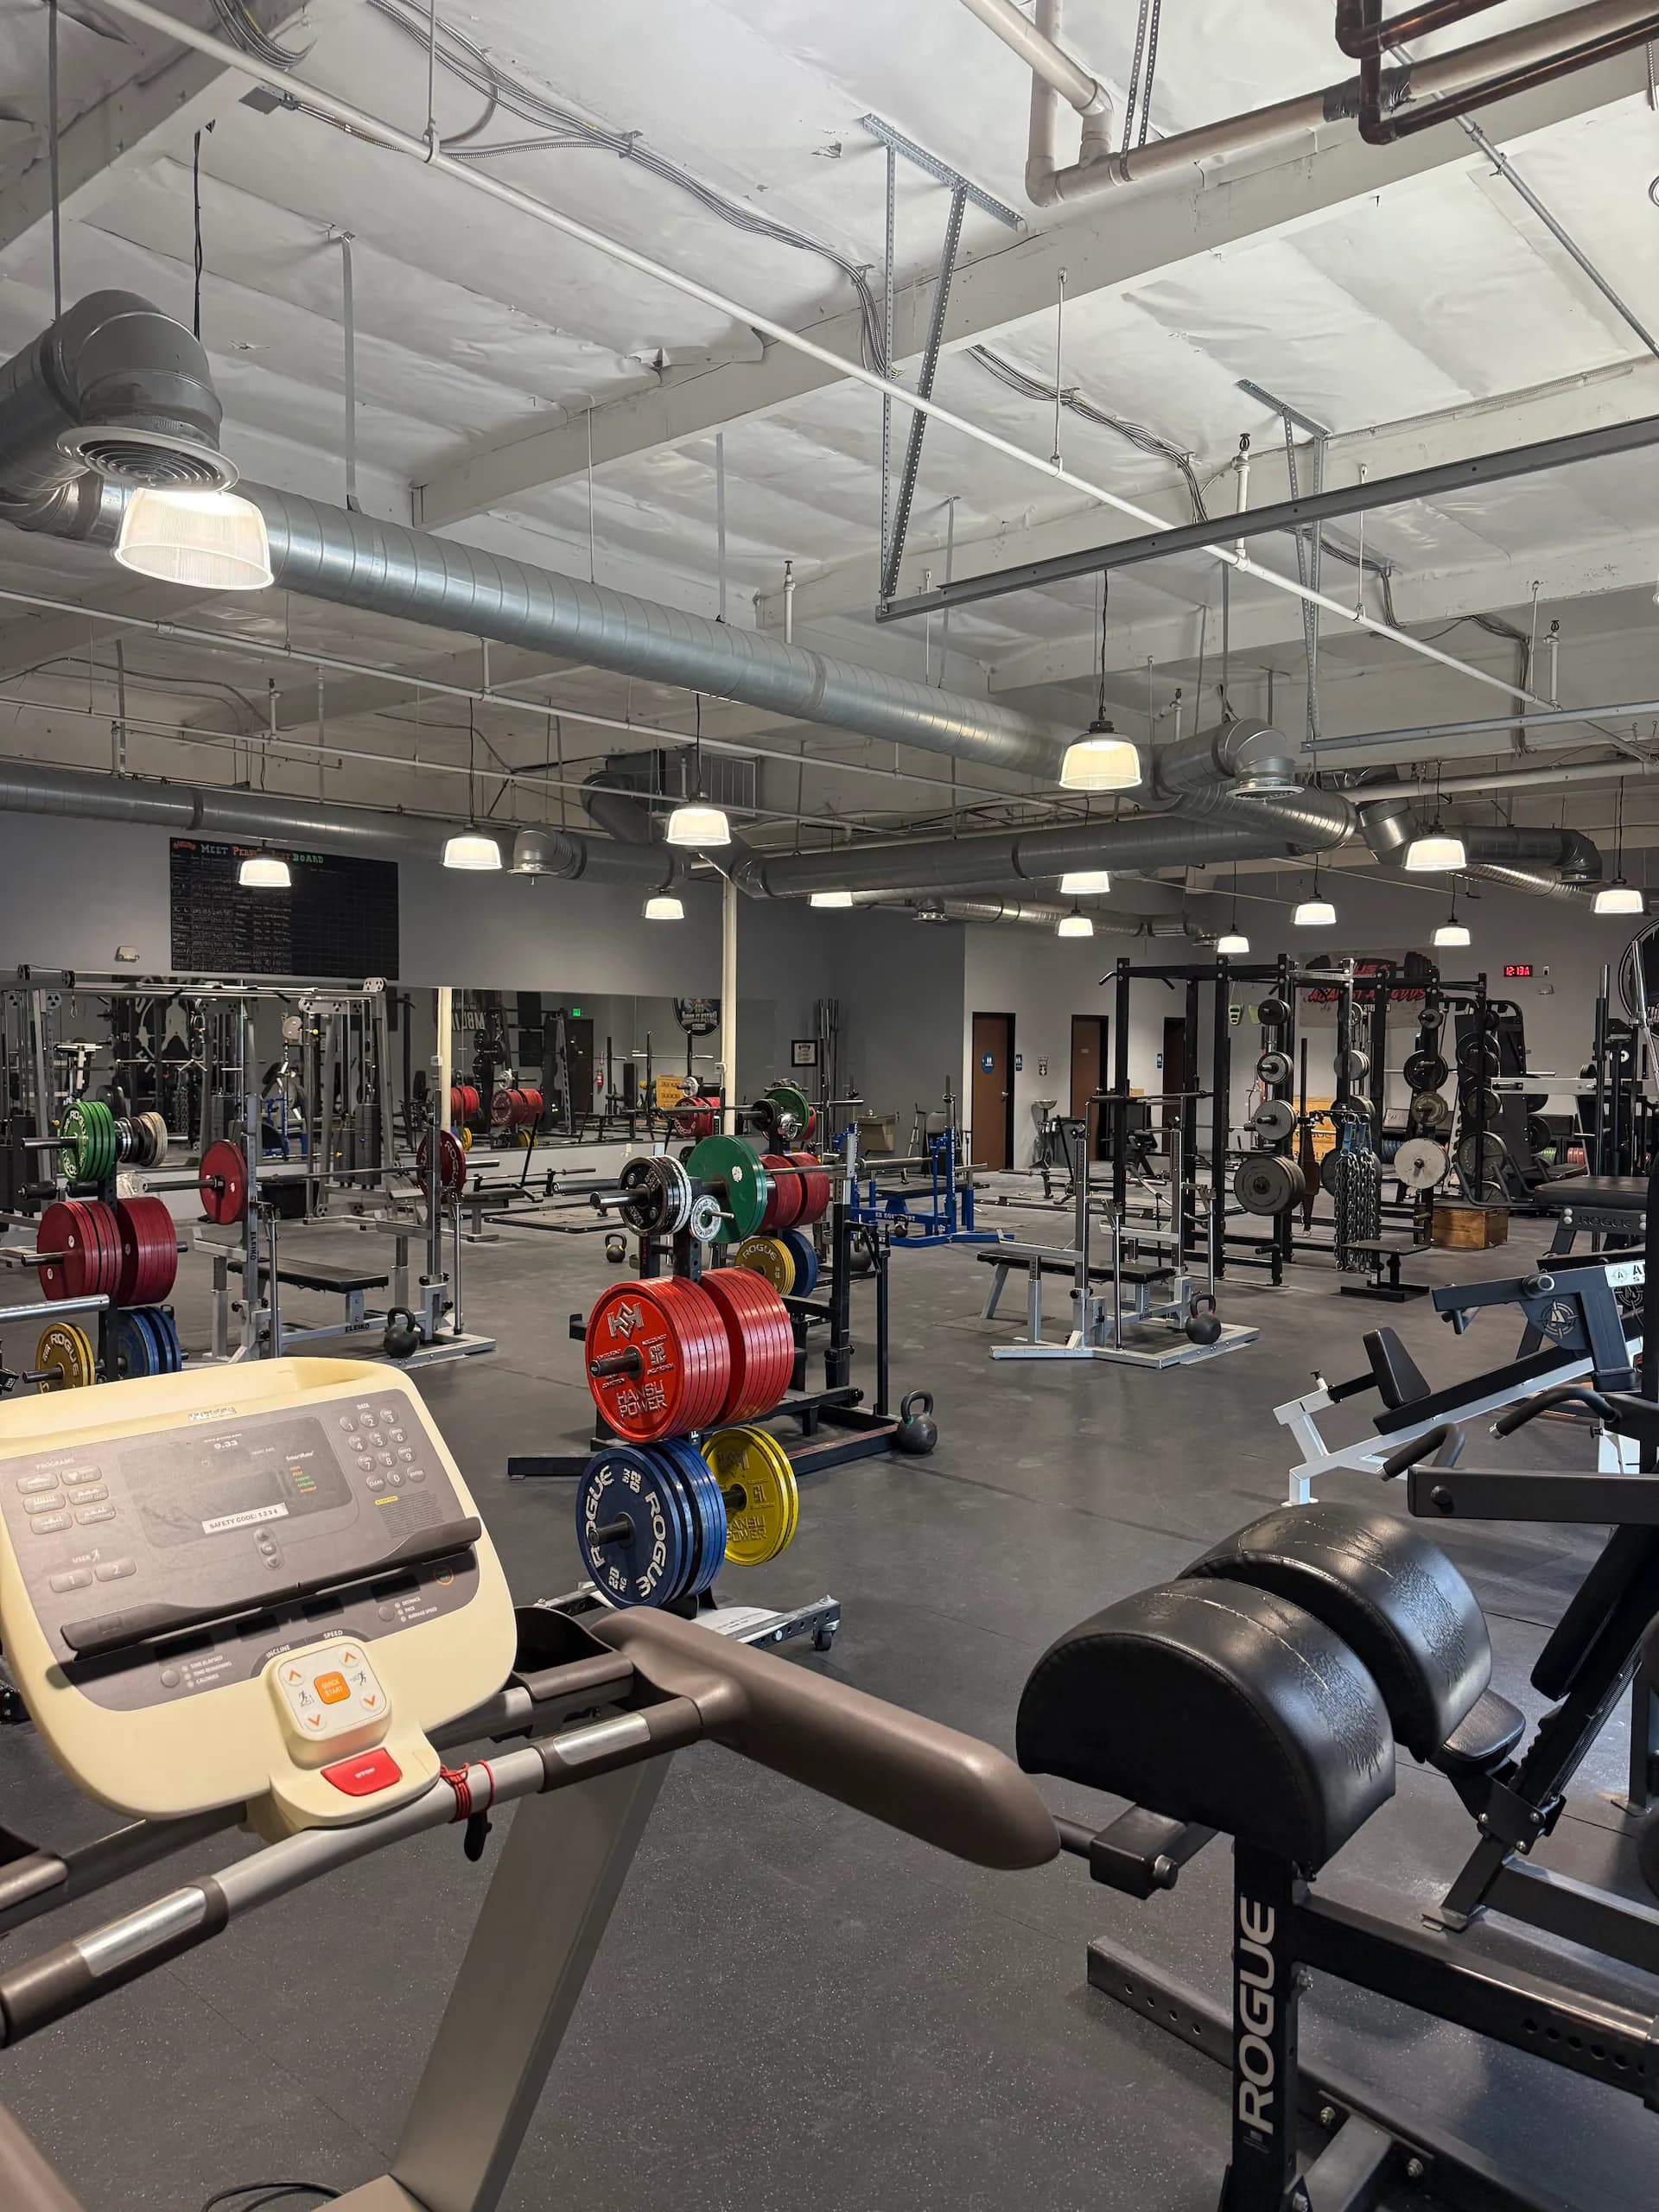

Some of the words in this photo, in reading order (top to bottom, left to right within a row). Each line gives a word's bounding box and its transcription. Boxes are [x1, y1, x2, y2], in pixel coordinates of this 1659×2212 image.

[200, 844, 228, 855] MEET
[292, 853, 324, 863] BOARD
[1577, 1216, 1632, 1228] ROGUE
[742, 1243, 778, 1262] ROGUE
[346, 1323, 370, 1333] ELEIKO
[50, 1333, 79, 1376] ROGUE
[616, 1379, 664, 1405] HANSU
[618, 1394, 668, 1419] POWER
[209, 1516, 235, 1529] SAFETY
[585, 1465, 615, 1569] ROGUE
[635, 1491, 667, 1599] ROGUE
[73, 1554, 91, 1563] USER
[323, 1630, 343, 1639] SPEED
[265, 1644, 291, 1658] INCLINE
[202, 1656, 223, 1666] ELAPSED
[321, 1679, 340, 1689] QUICK
[325, 1686, 343, 1697] START
[1239, 1897, 1276, 2136] ROGUE
